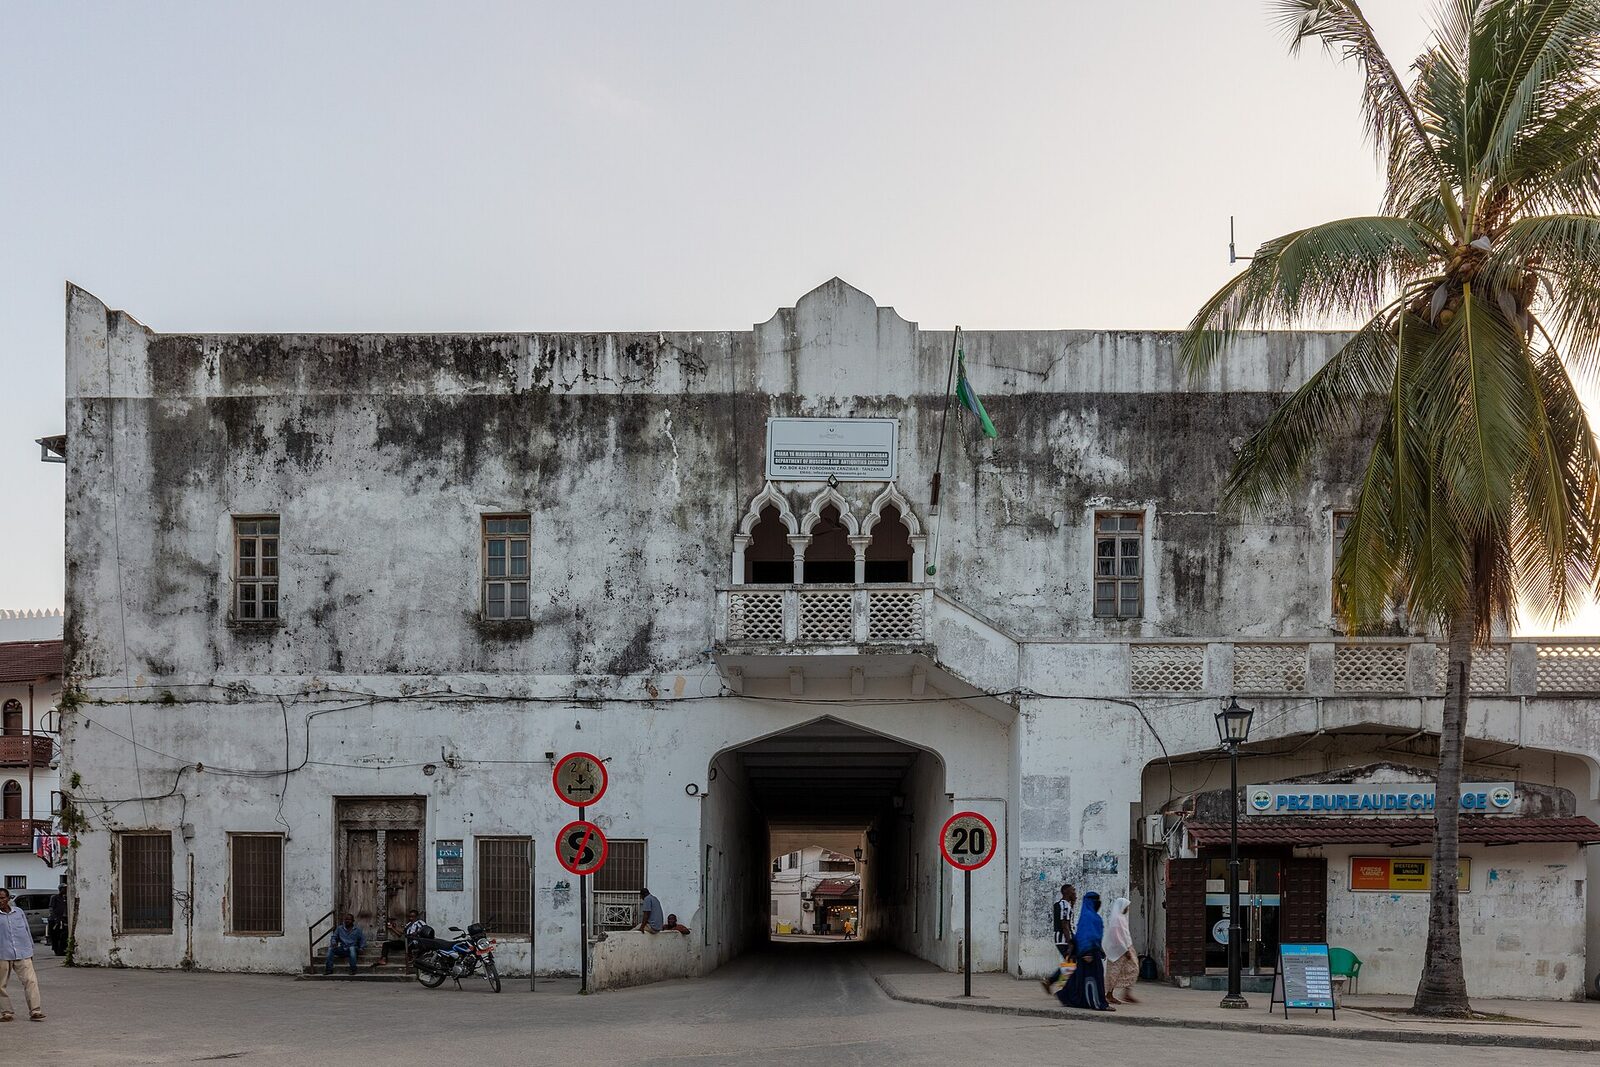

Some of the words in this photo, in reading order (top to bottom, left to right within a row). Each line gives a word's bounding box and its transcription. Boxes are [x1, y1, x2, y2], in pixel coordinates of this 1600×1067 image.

[570, 762, 577, 772] 2
[1276, 794, 1310, 811] PBZ
[1311, 794, 1383, 811] BUREAU
[1384, 794, 1408, 811] DE
[1409, 793, 1487, 810] CHGE
[952, 827, 985, 855] 20
